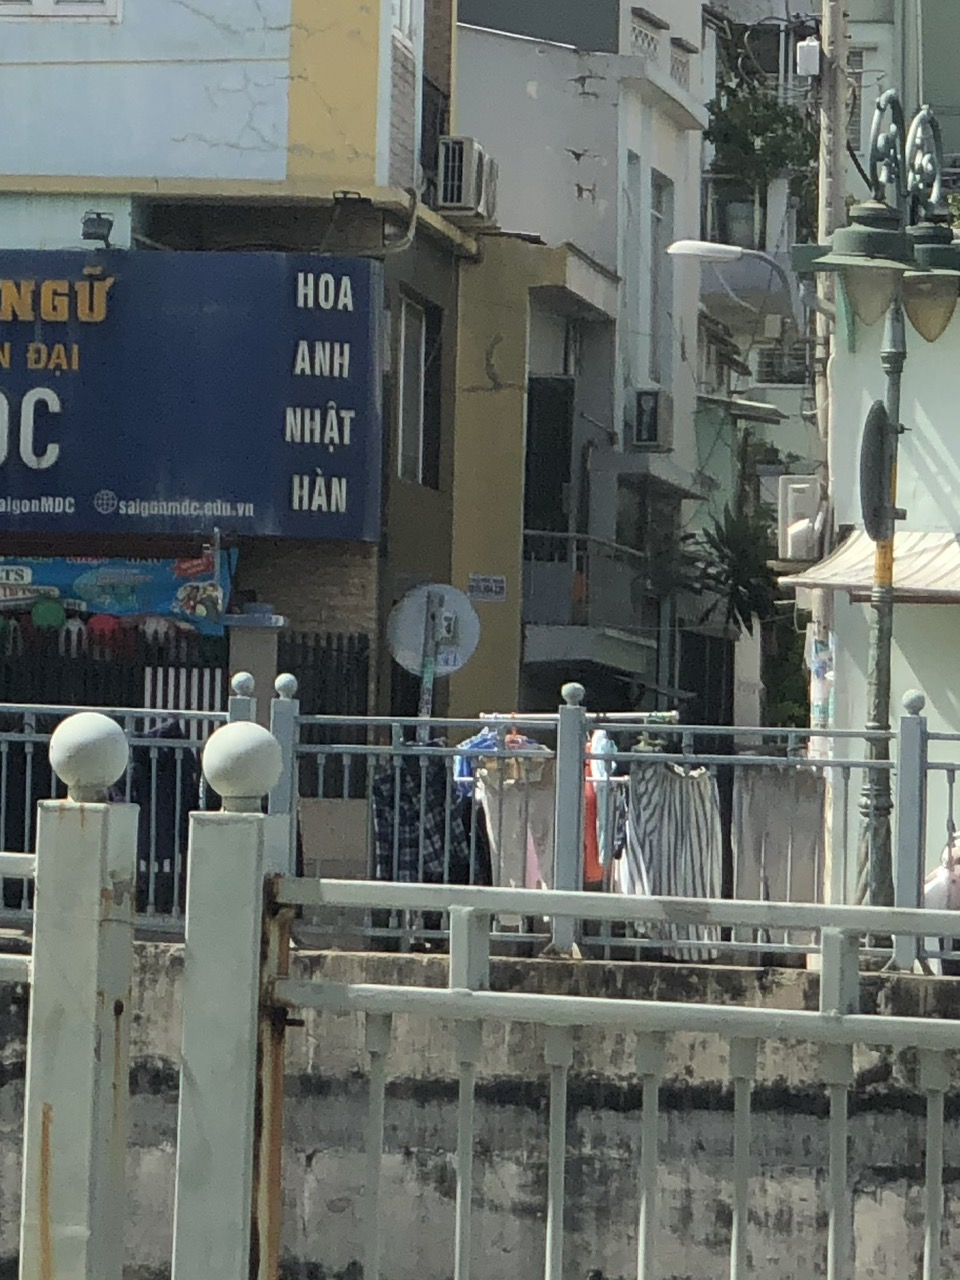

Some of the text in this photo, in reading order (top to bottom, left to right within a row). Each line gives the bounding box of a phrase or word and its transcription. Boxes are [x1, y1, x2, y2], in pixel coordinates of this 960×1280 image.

[297, 272, 353, 311] HOA
[26, 342, 79, 376] ĐẠI
[294, 340, 350, 378] ANH
[285, 400, 356, 453] NHẬT
[292, 467, 347, 512] HÀN
